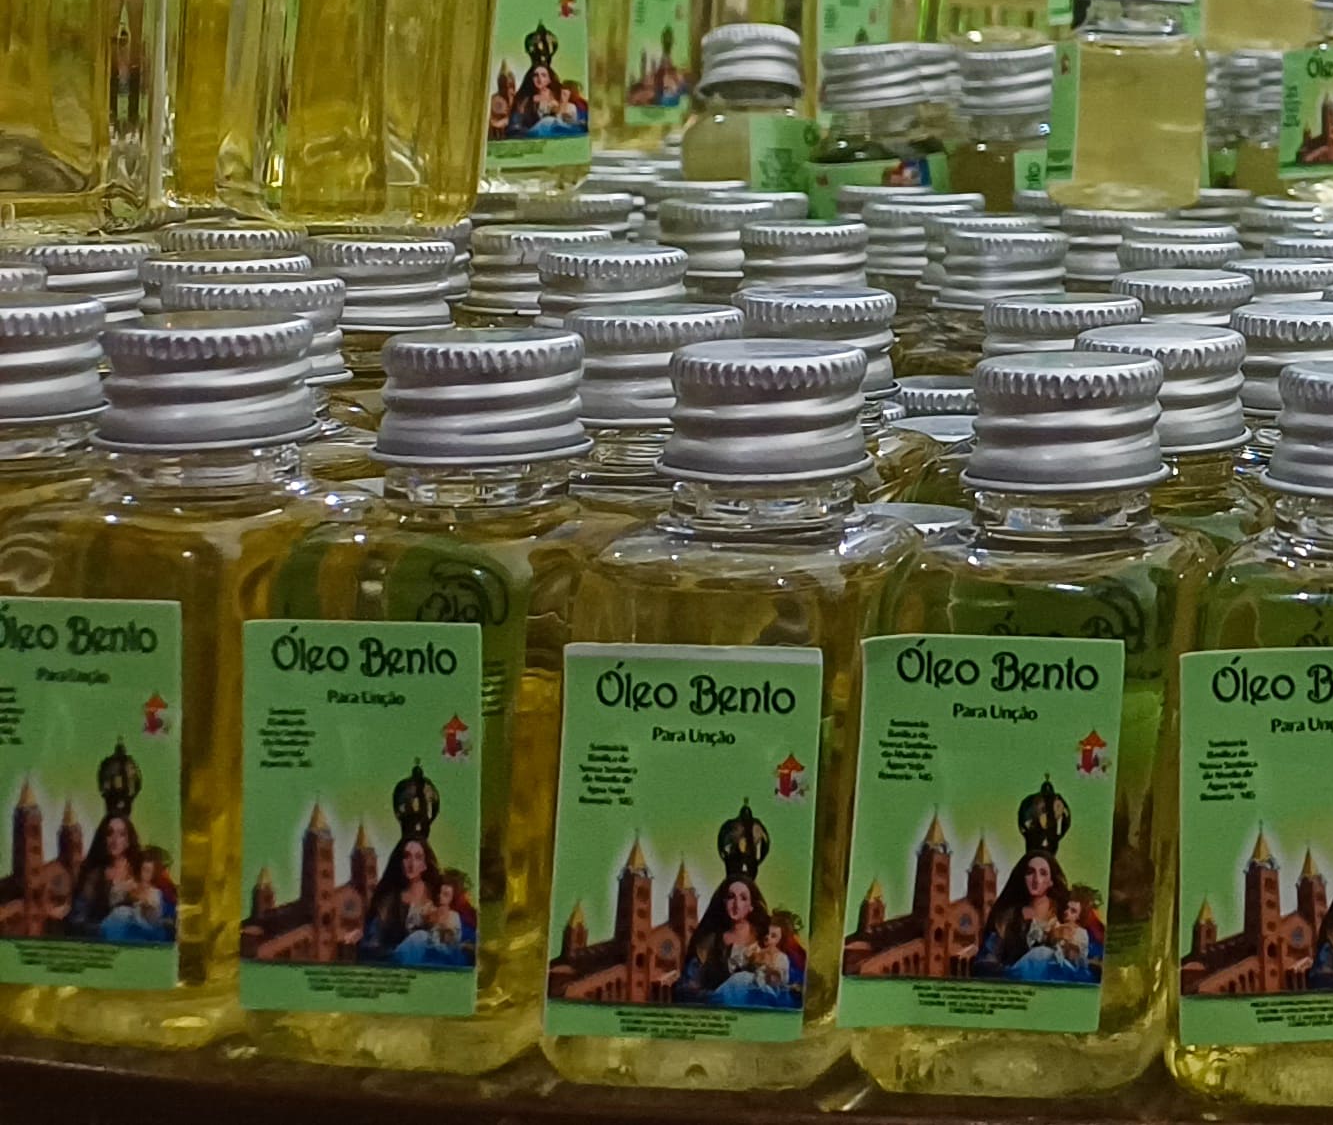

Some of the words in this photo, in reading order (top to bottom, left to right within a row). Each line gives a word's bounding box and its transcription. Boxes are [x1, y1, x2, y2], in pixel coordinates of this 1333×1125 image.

[66, 615, 158, 655] Bento
[272, 625, 349, 674] Óleo
[360, 636, 457, 677] Bento
[897, 638, 980, 688] Óleo
[991, 651, 1098, 692] Bento
[1212, 656, 1295, 705] Óleo
[596, 662, 677, 712] Óleo
[689, 675, 796, 715] Bento
[953, 703, 987, 718] Para
[990, 705, 1038, 723] Unção
[1271, 718, 1305, 733] Para
[652, 727, 686, 741] Para
[689, 728, 736, 746] Unção
